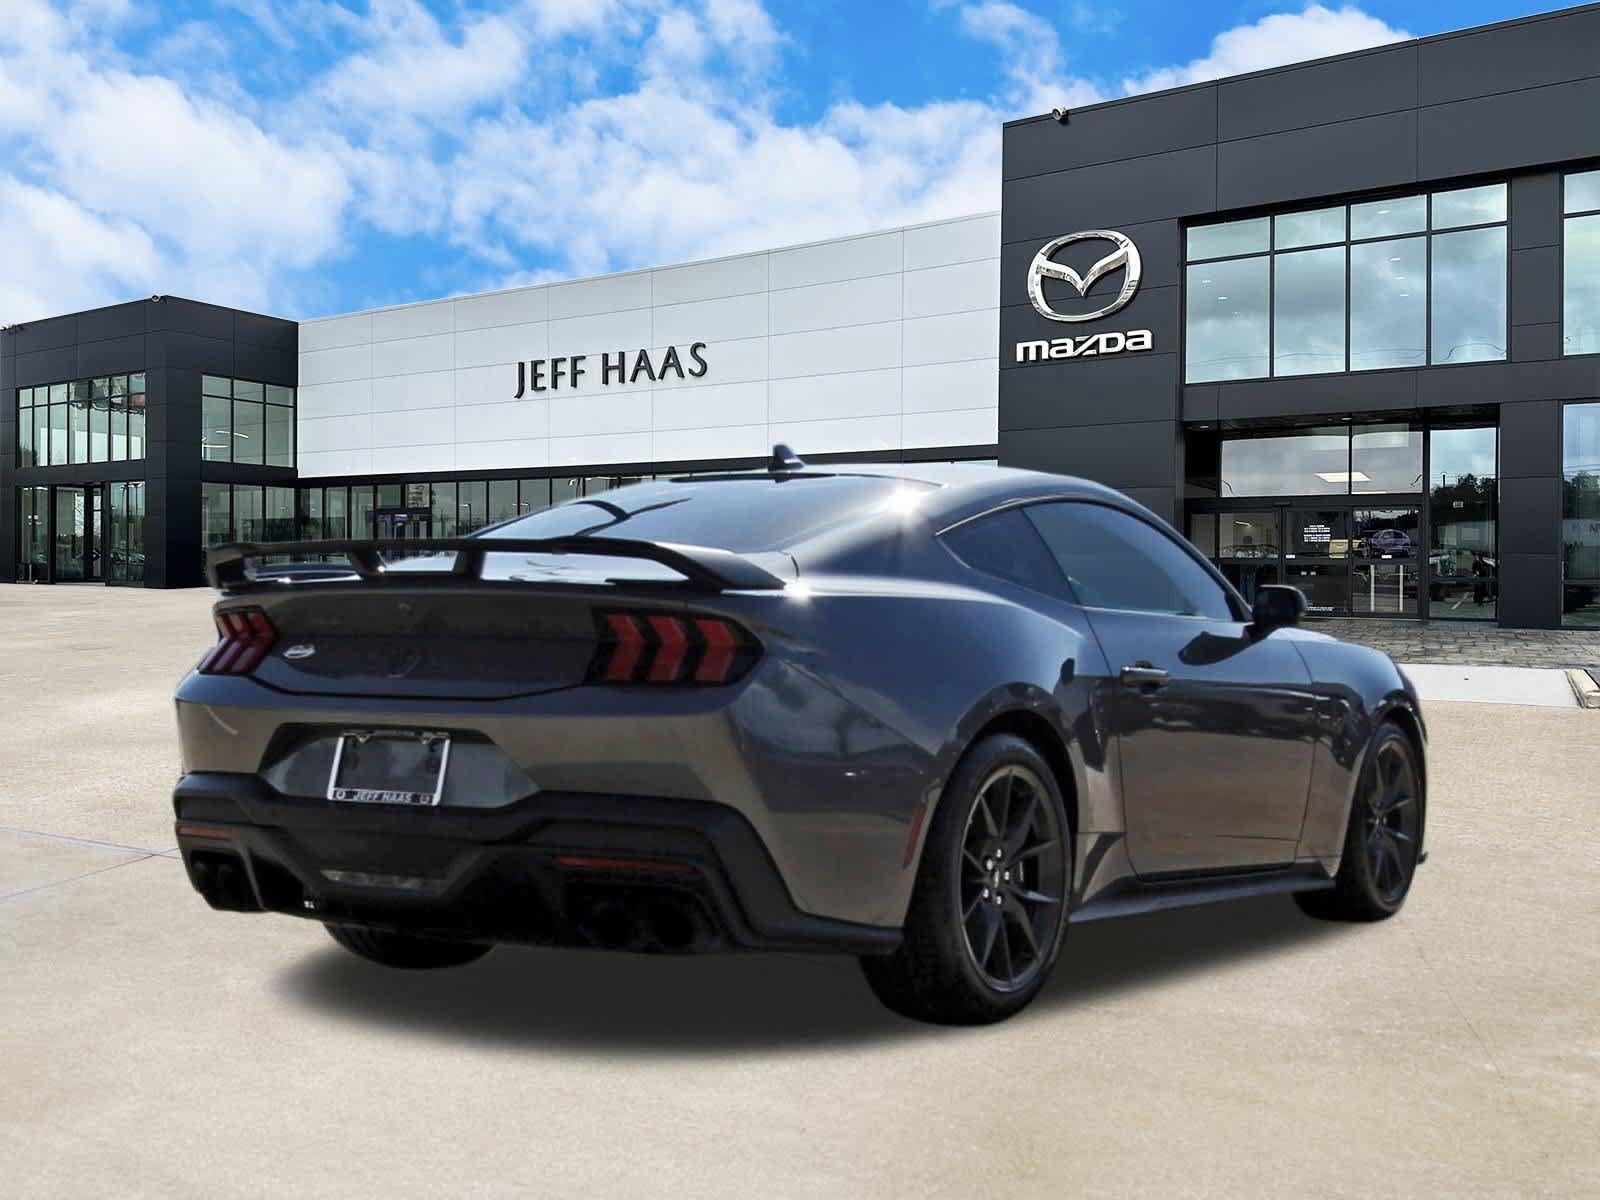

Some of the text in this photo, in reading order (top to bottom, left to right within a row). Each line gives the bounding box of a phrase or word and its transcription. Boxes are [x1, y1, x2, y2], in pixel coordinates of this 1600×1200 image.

[514, 342, 708, 399] JEFF HAAS
[353, 791, 411, 803] JEFF HAAS
